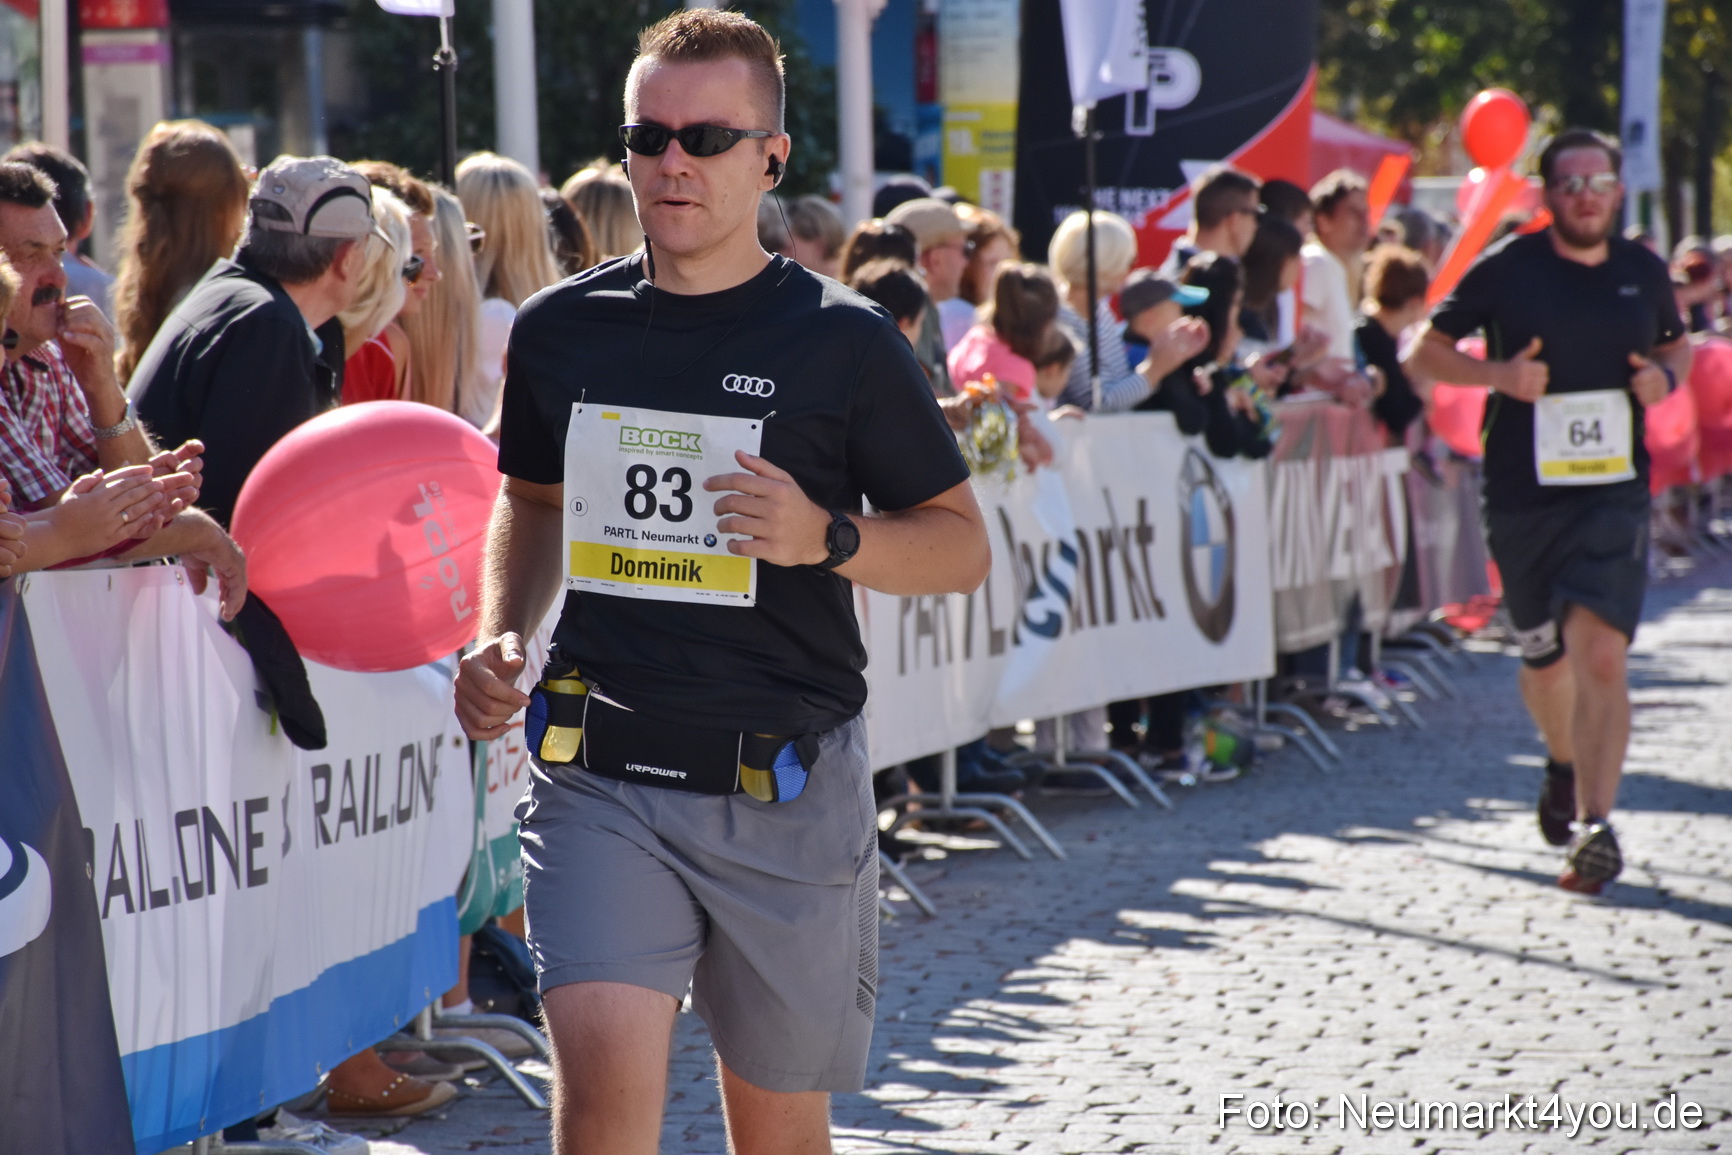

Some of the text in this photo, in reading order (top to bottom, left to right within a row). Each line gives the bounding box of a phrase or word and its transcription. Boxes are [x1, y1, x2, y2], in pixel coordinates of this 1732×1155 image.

[620, 426, 702, 453] BOCK
[1568, 418, 1603, 447] 64
[618, 446, 645, 455] inspired
[676, 452, 703, 460] concepts
[624, 464, 693, 522] 83
[575, 501, 583, 512] D
[603, 525, 700, 545] PARTL Neumarkt
[611, 552, 703, 583] Dominik
[625, 763, 687, 779] URPOWER
